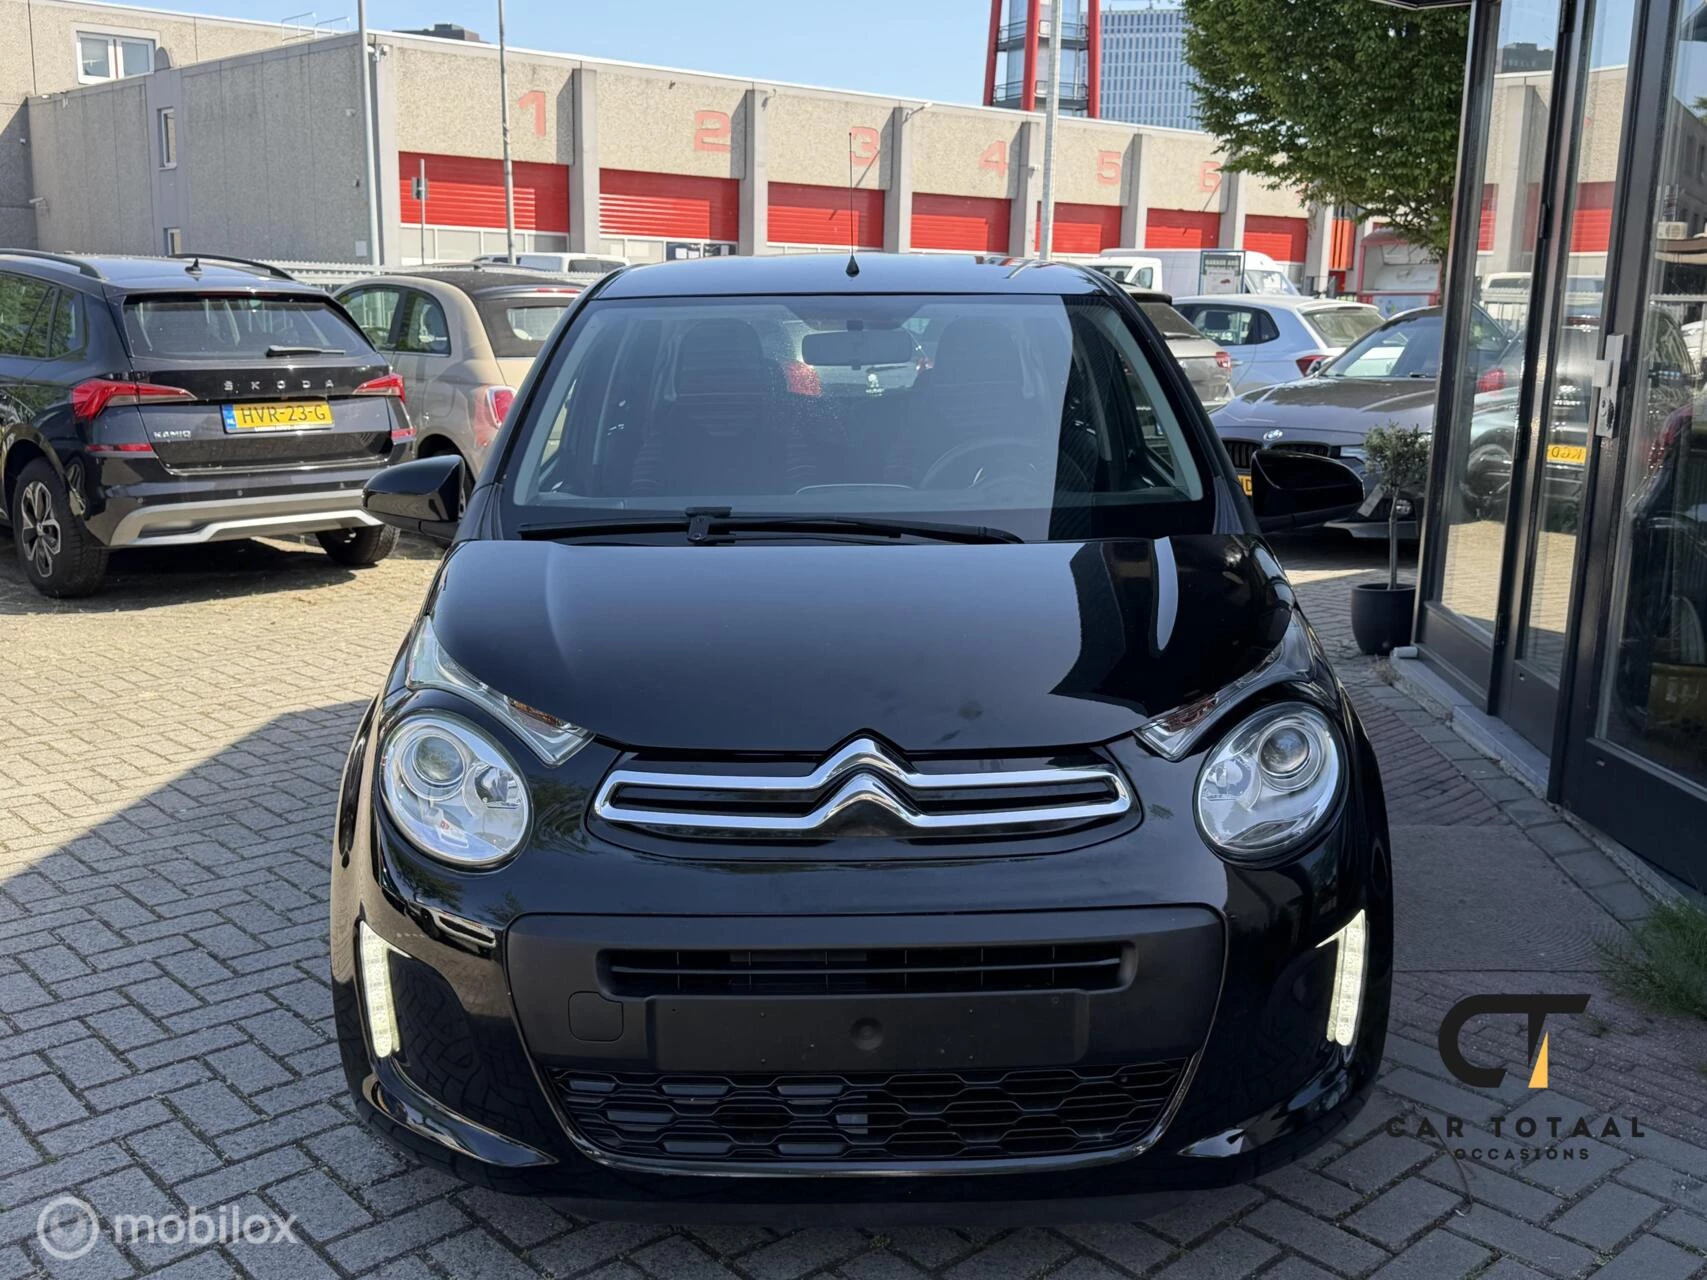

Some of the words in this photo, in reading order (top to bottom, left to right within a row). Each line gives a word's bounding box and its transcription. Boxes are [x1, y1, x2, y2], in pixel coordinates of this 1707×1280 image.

[518, 90, 546, 136] 1
[694, 110, 732, 153] 2
[850, 126, 880, 166] 3
[979, 140, 1009, 177] 4
[1097, 150, 1122, 186] 5
[1201, 160, 1222, 193] 6
[240, 404, 326, 424] HVR-23-G
